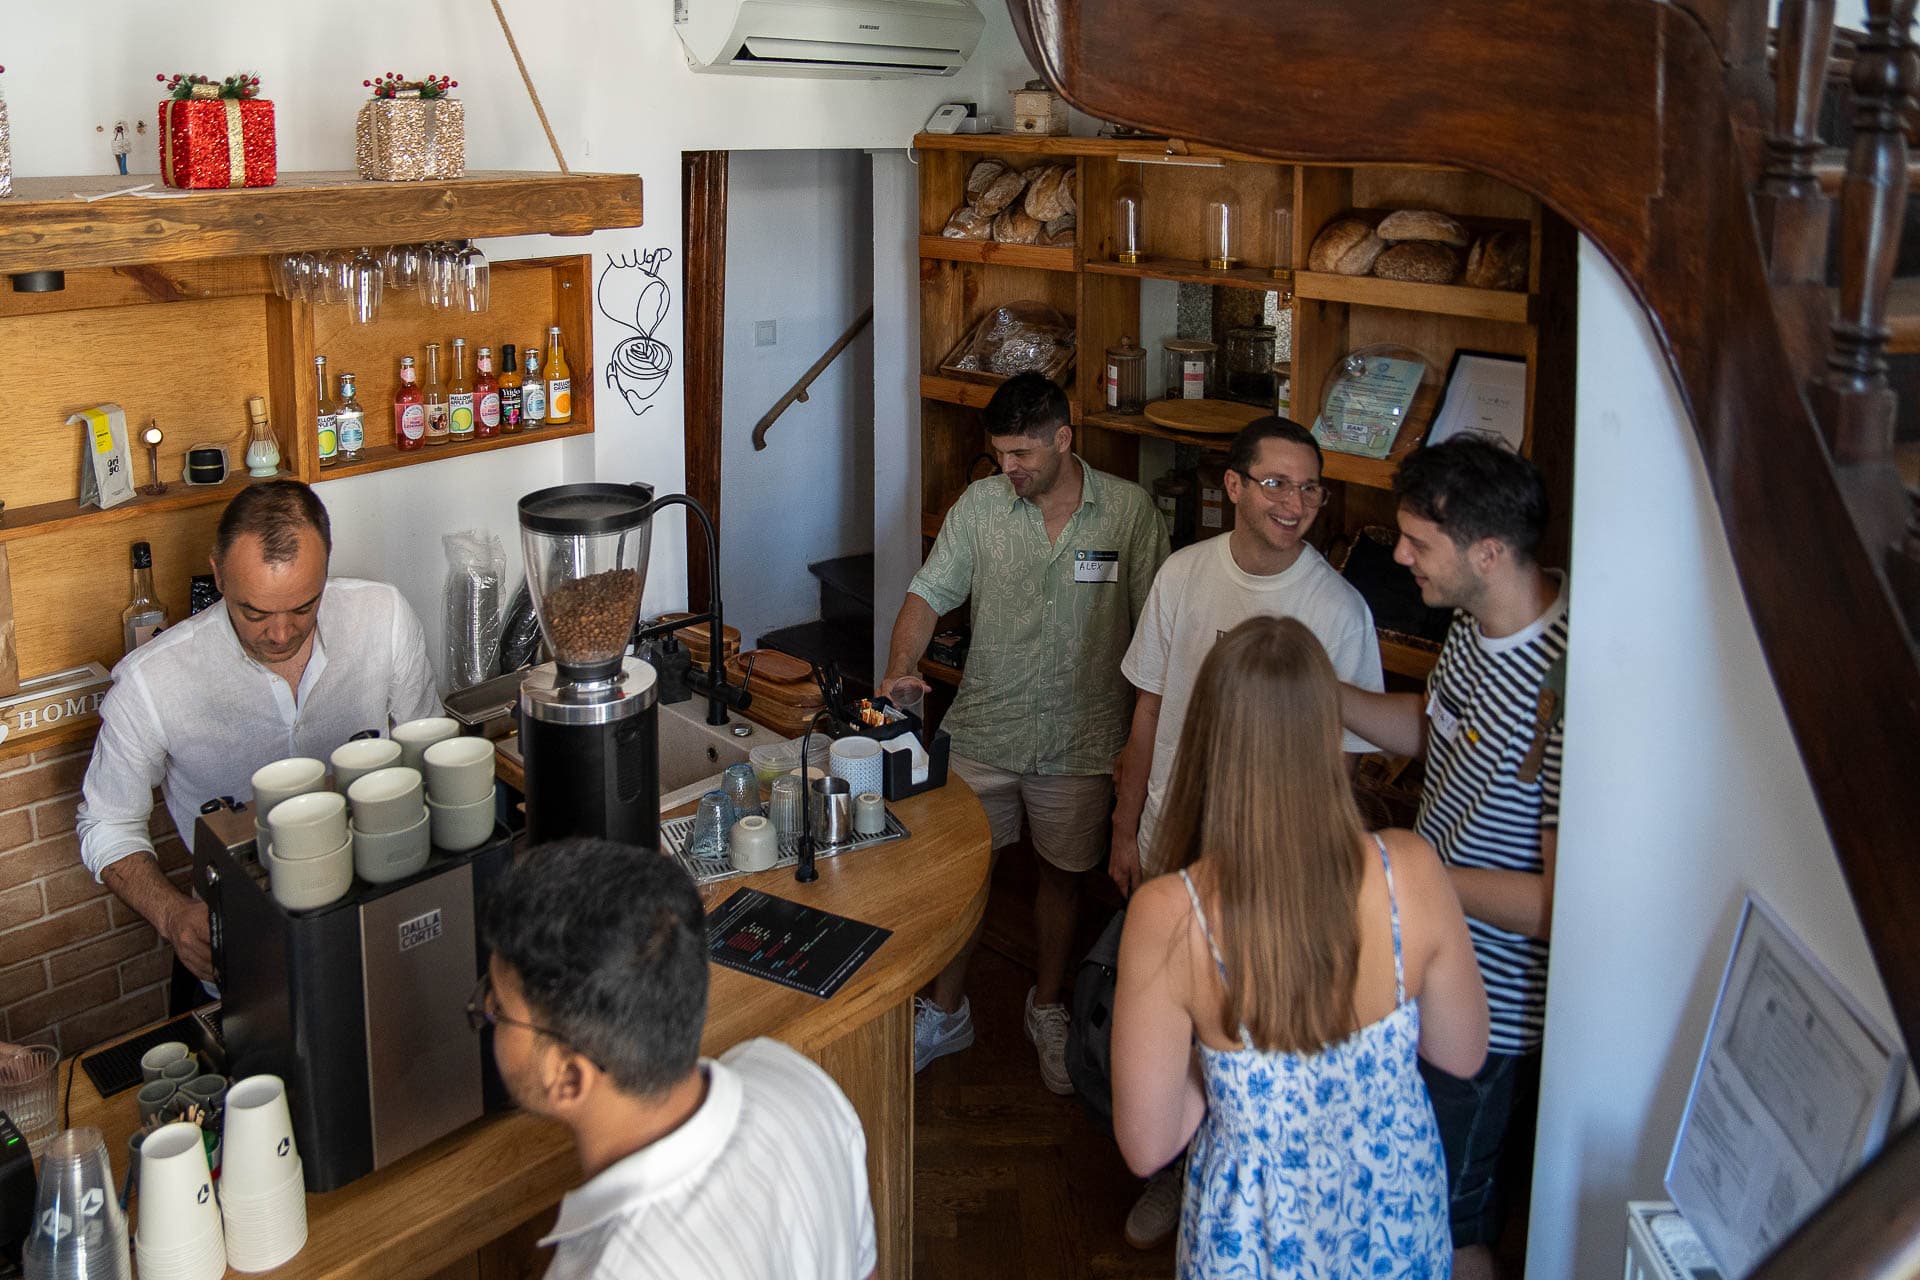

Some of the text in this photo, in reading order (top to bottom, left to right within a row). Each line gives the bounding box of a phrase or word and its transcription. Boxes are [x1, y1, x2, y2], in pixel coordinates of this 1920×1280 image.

[1079, 561, 1104, 571] ALEX
[401, 912, 440, 937] DALLA
[402, 923, 441, 949] CORTE
